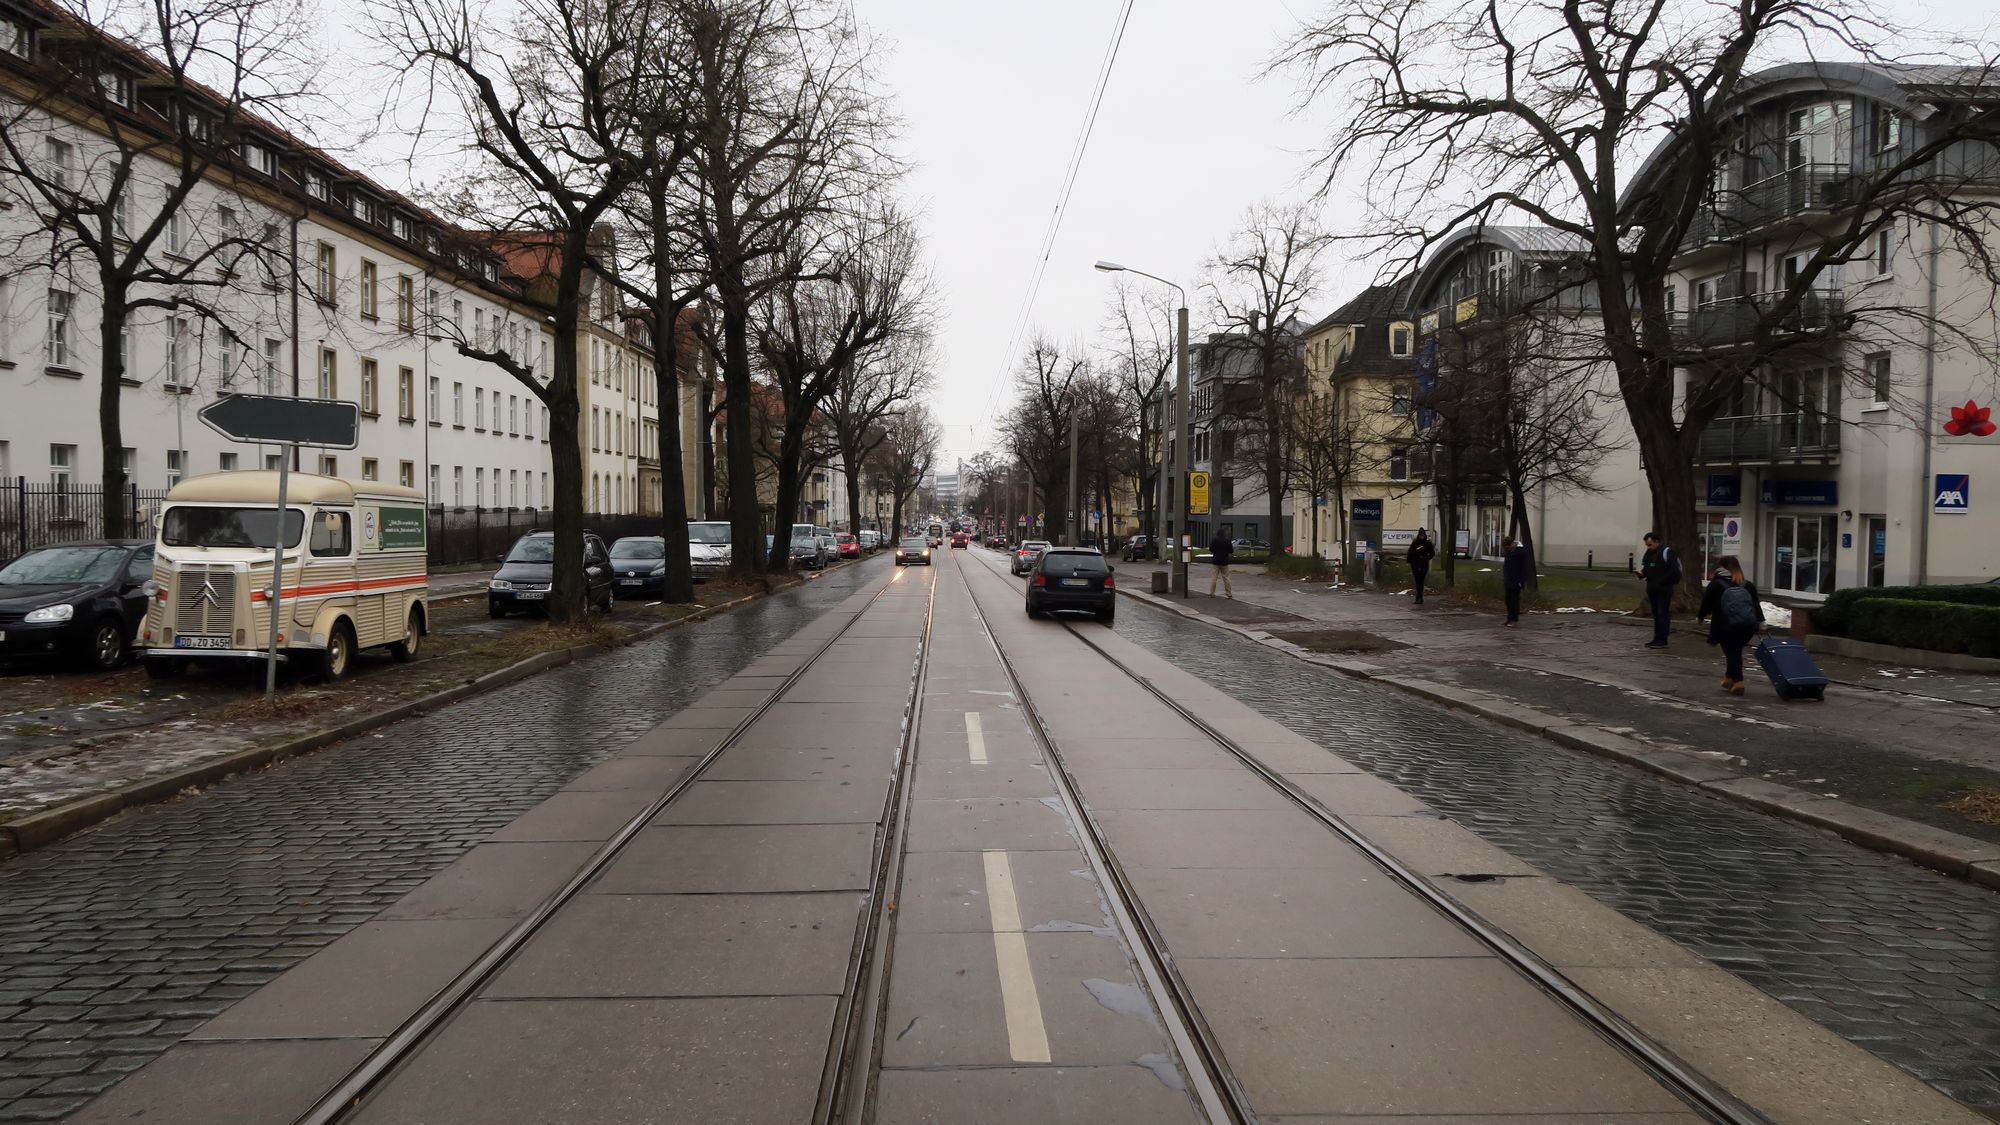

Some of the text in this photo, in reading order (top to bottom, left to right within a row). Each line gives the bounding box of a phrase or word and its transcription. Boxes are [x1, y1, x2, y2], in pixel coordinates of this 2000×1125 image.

[1935, 490, 1965, 505] AXA
[181, 638, 191, 647] DD
[209, 639, 230, 648] 345H
